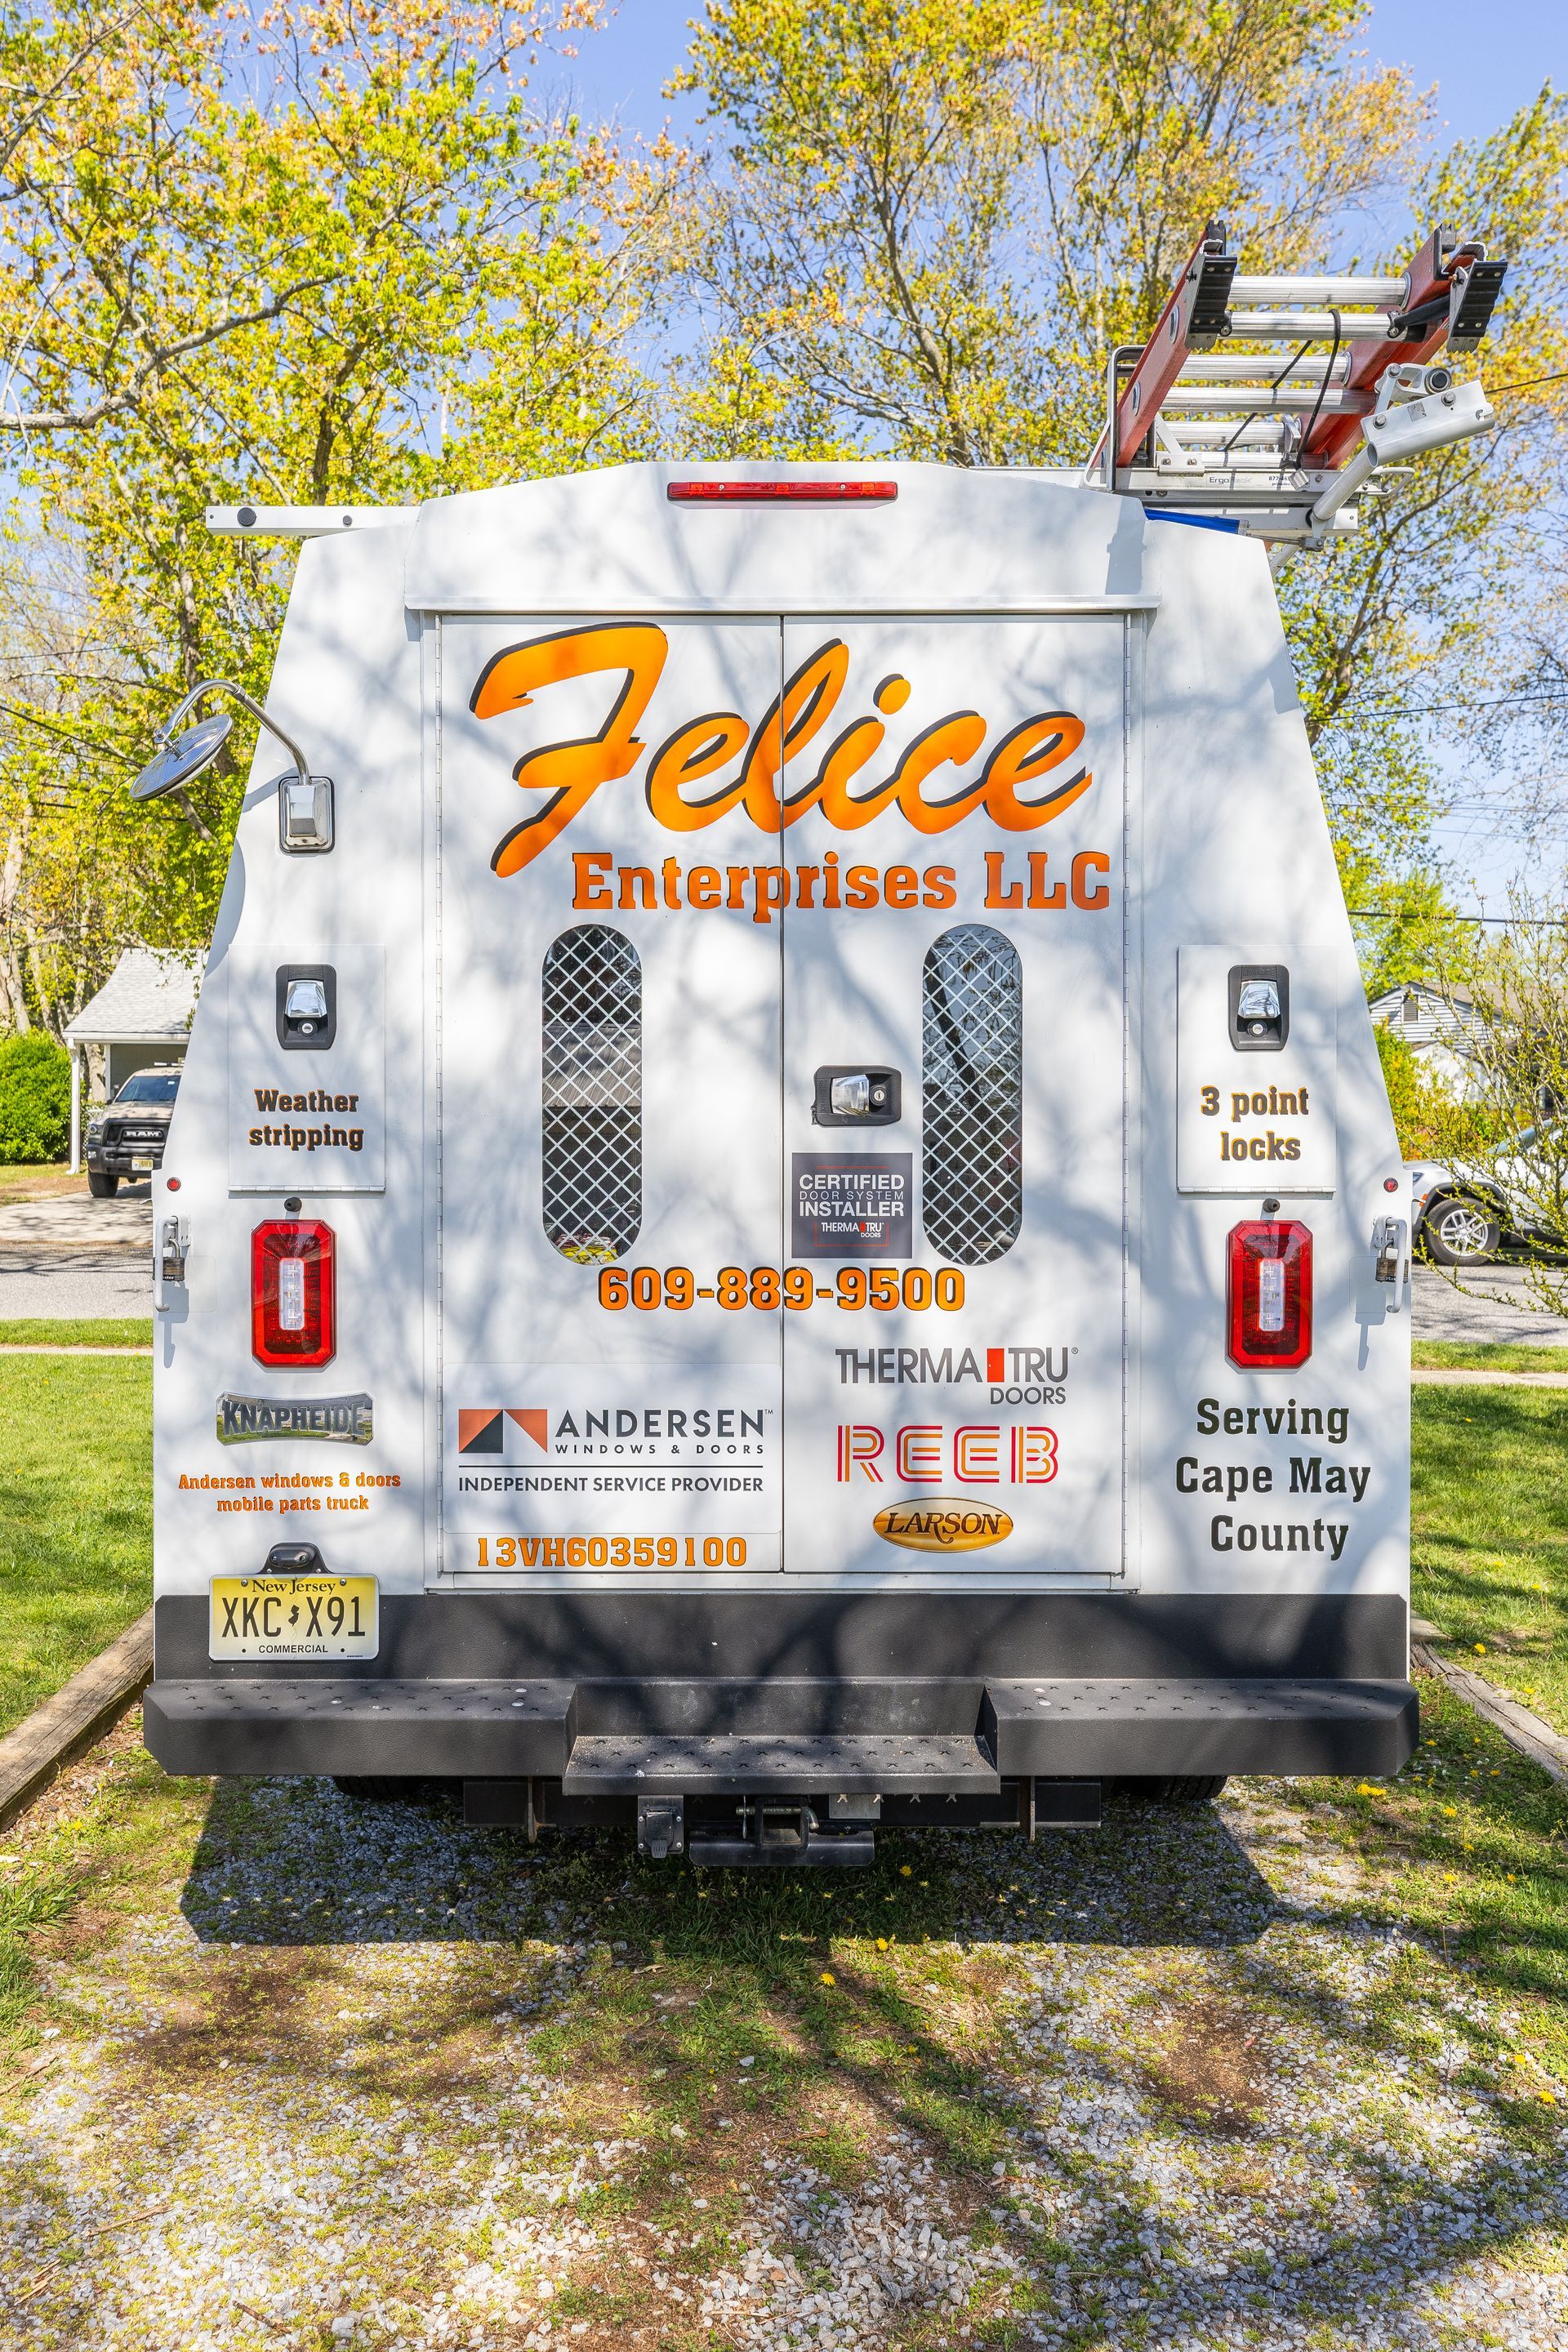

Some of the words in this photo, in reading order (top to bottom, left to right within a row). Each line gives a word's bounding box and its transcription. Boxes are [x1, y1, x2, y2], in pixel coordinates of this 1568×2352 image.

[470, 621, 1092, 878] Felice
[572, 851, 956, 923] Enterprises
[984, 851, 1110, 910] LLC
[253, 1089, 359, 1112] Weather
[1200, 1085, 1220, 1116] 3
[1231, 1085, 1309, 1122] point
[248, 1123, 364, 1152] stripping
[1220, 1130, 1301, 1160] locks
[799, 1174, 905, 1190] CERTIFIED
[800, 1191, 840, 1200] DOOR
[846, 1191, 904, 1200] SYSTEM
[800, 1201, 905, 1217] INSTALLER
[821, 1222, 859, 1232] THERMA
[598, 1267, 965, 1311] 609-889-9500
[835, 1348, 983, 1383] THERMA
[990, 1387, 1067, 1405] DOORS
[221, 1400, 367, 1437] KNAPHEIDE
[1196, 1397, 1349, 1444] Serving
[555, 1444, 656, 1454] WINDOWS
[671, 1444, 681, 1454] &
[696, 1444, 764, 1454] DOORS
[837, 1425, 1058, 1484] REEB
[179, 1474, 256, 1490] Andersen
[261, 1473, 333, 1489] windows
[339, 1472, 350, 1487] &
[355, 1472, 401, 1487] doors
[459, 1477, 587, 1491] INDEPENDENT
[594, 1477, 666, 1491] SERVICE
[671, 1477, 764, 1491] PROVIDER
[1176, 1456, 1272, 1502] Cape
[1289, 1457, 1371, 1503] May
[217, 1497, 274, 1512] mobile
[279, 1498, 321, 1514] parts
[327, 1495, 369, 1510] truck
[884, 1512, 1003, 1544] LARSON
[1211, 1514, 1349, 1561] County
[478, 1537, 747, 1567] 13VH60359100
[252, 1579, 287, 1592] New
[289, 1579, 336, 1595] Jersey
[221, 1597, 282, 1637] XKC
[305, 1597, 366, 1637] X91
[258, 1645, 328, 1654] COMMERCIAL
